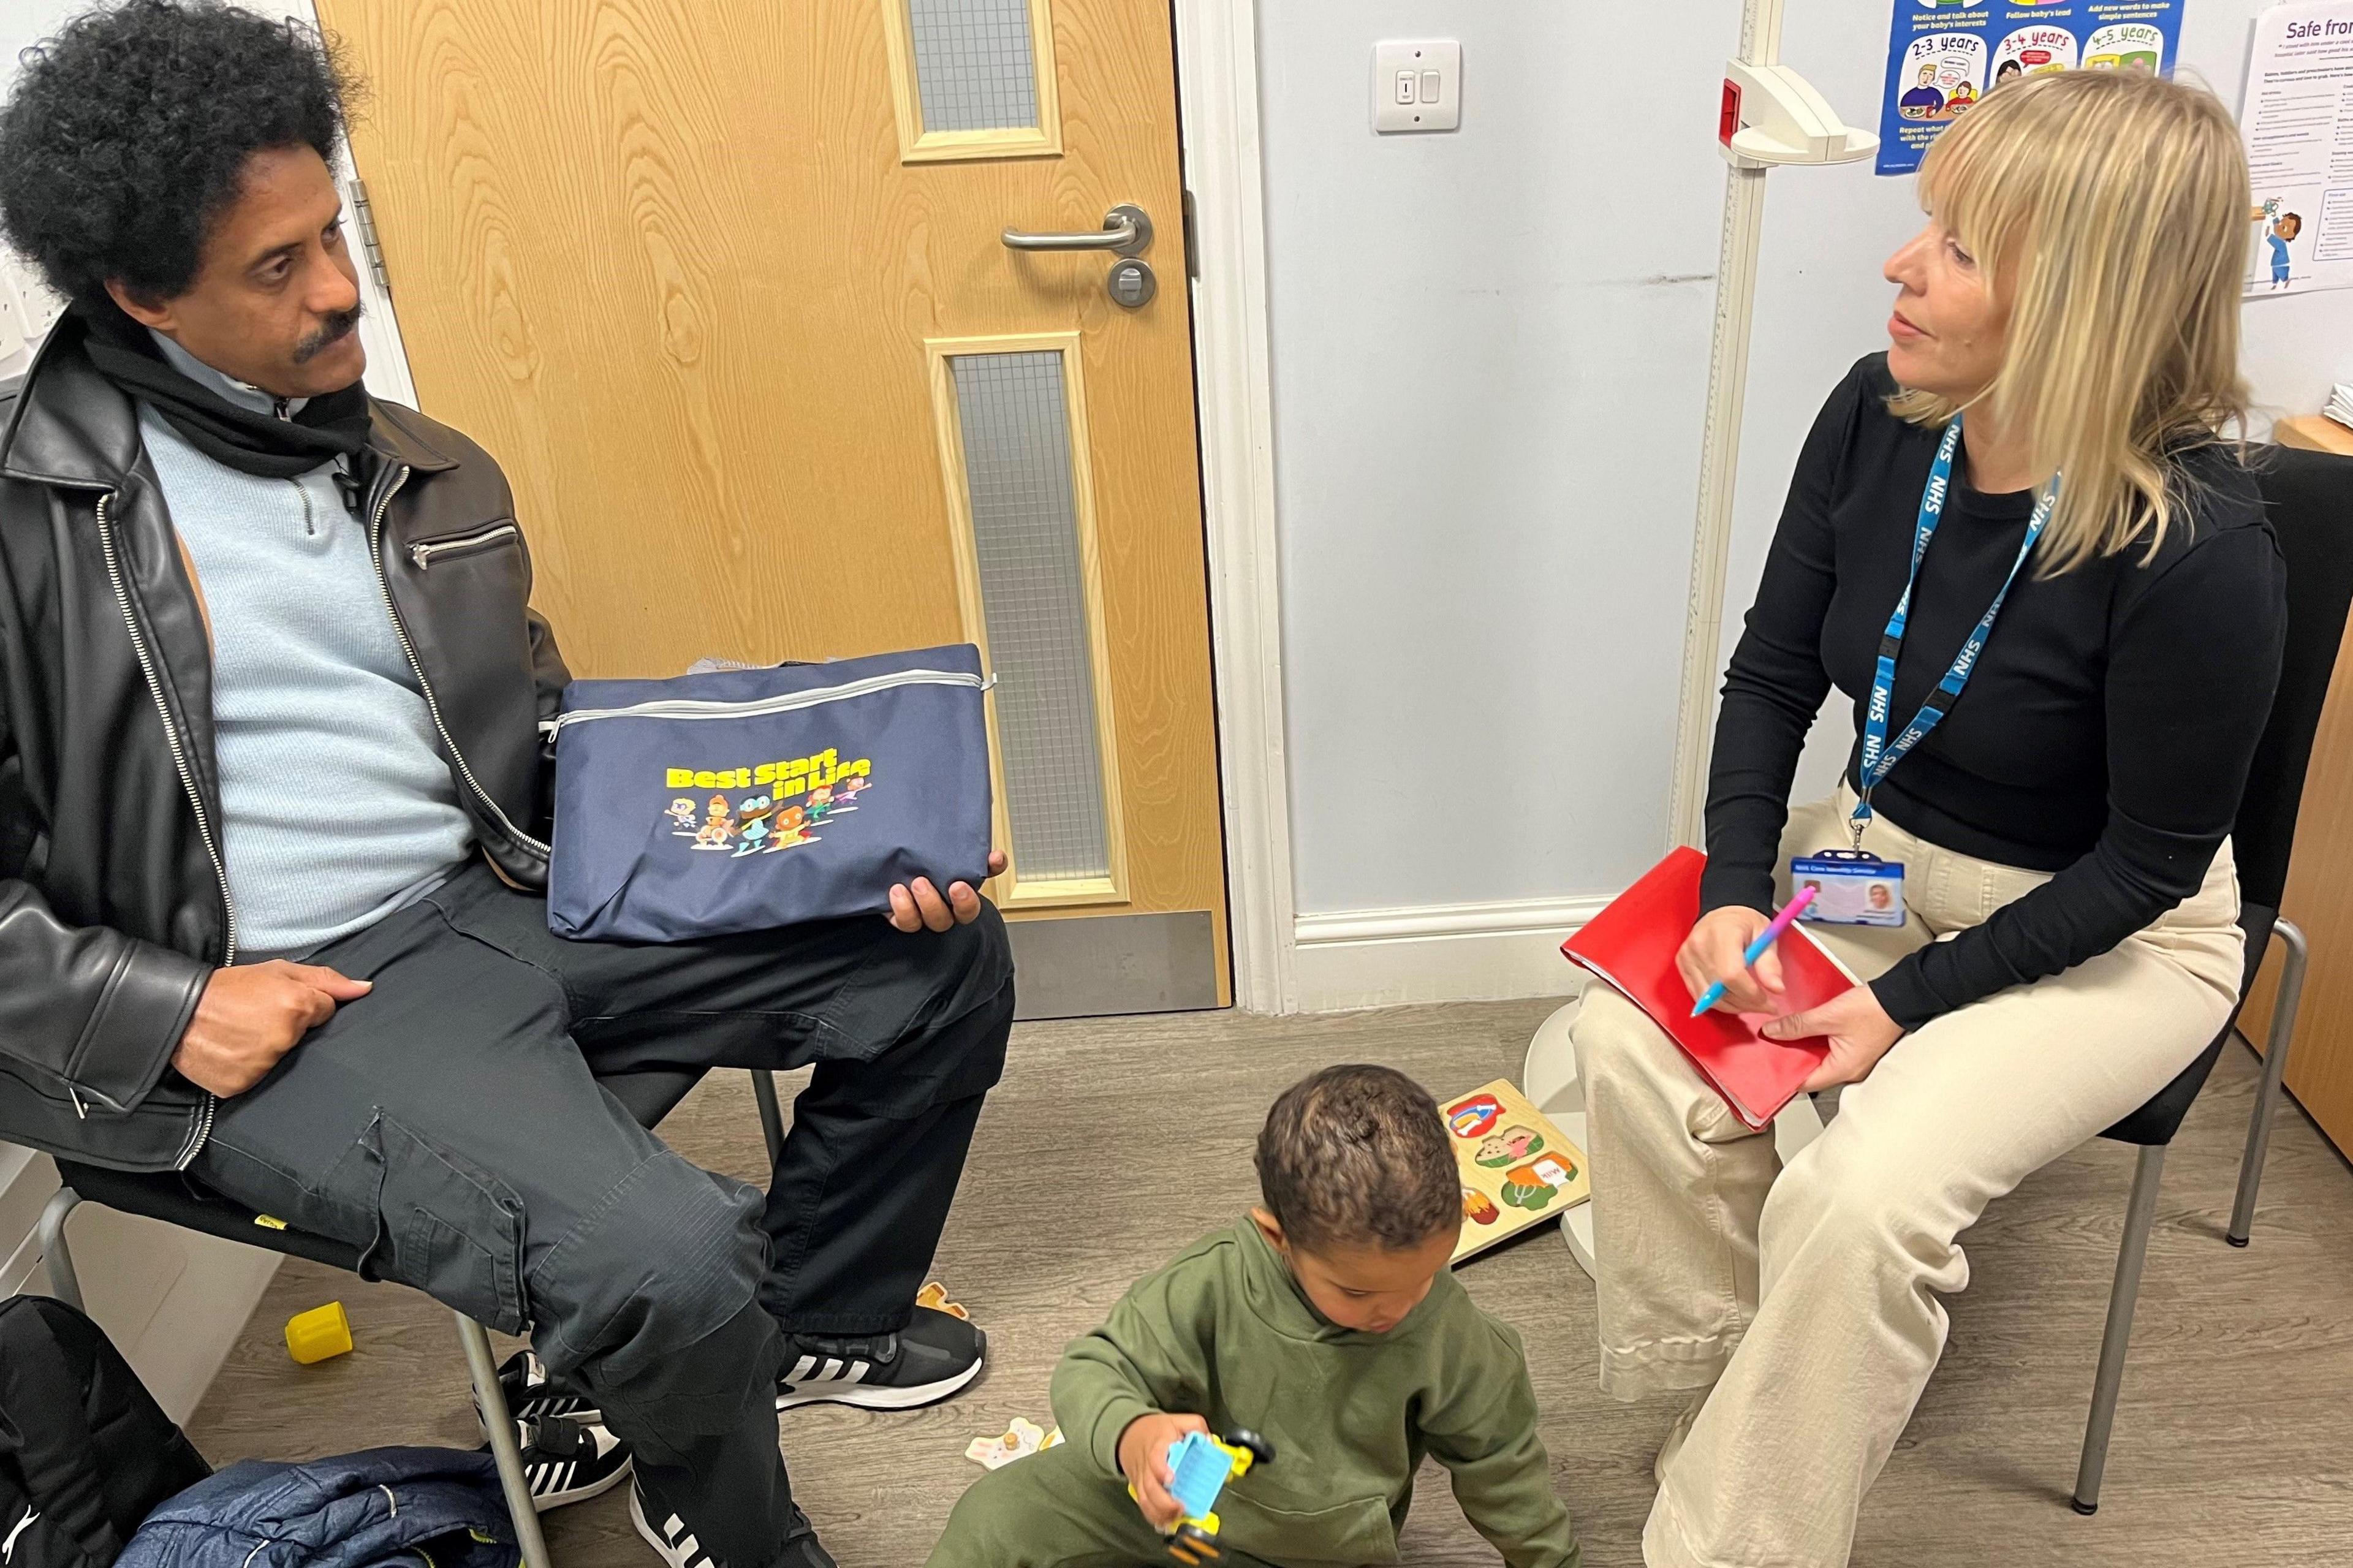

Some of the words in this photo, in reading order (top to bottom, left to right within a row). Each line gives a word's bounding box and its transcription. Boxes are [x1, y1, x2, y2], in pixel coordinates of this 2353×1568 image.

[1931, 21, 1953, 29] baby's
[2004, 34, 2026, 51] 3-4
[2032, 32, 2069, 46] years
[2093, 29, 2113, 45] 4-5
[2121, 27, 2158, 41] years
[2286, 20, 2321, 39] Safe
[1912, 38, 1933, 56] 2-3
[1941, 37, 1979, 51] years
[1940, 424, 1960, 463] NHS
[1925, 475, 1946, 514] NHS
[2030, 491, 2056, 531] NHS
[1915, 526, 1932, 564] NHS
[1953, 639, 1980, 676] NHS
[1870, 685, 1888, 723] NHS
[1863, 734, 1881, 768] NHS
[1895, 727, 1922, 751] NHS
[666, 767, 751, 789] Best
[754, 748, 838, 785] Start
[773, 776, 806, 801] in
[808, 758, 871, 791] Life
[1873, 754, 1896, 777] NHS
